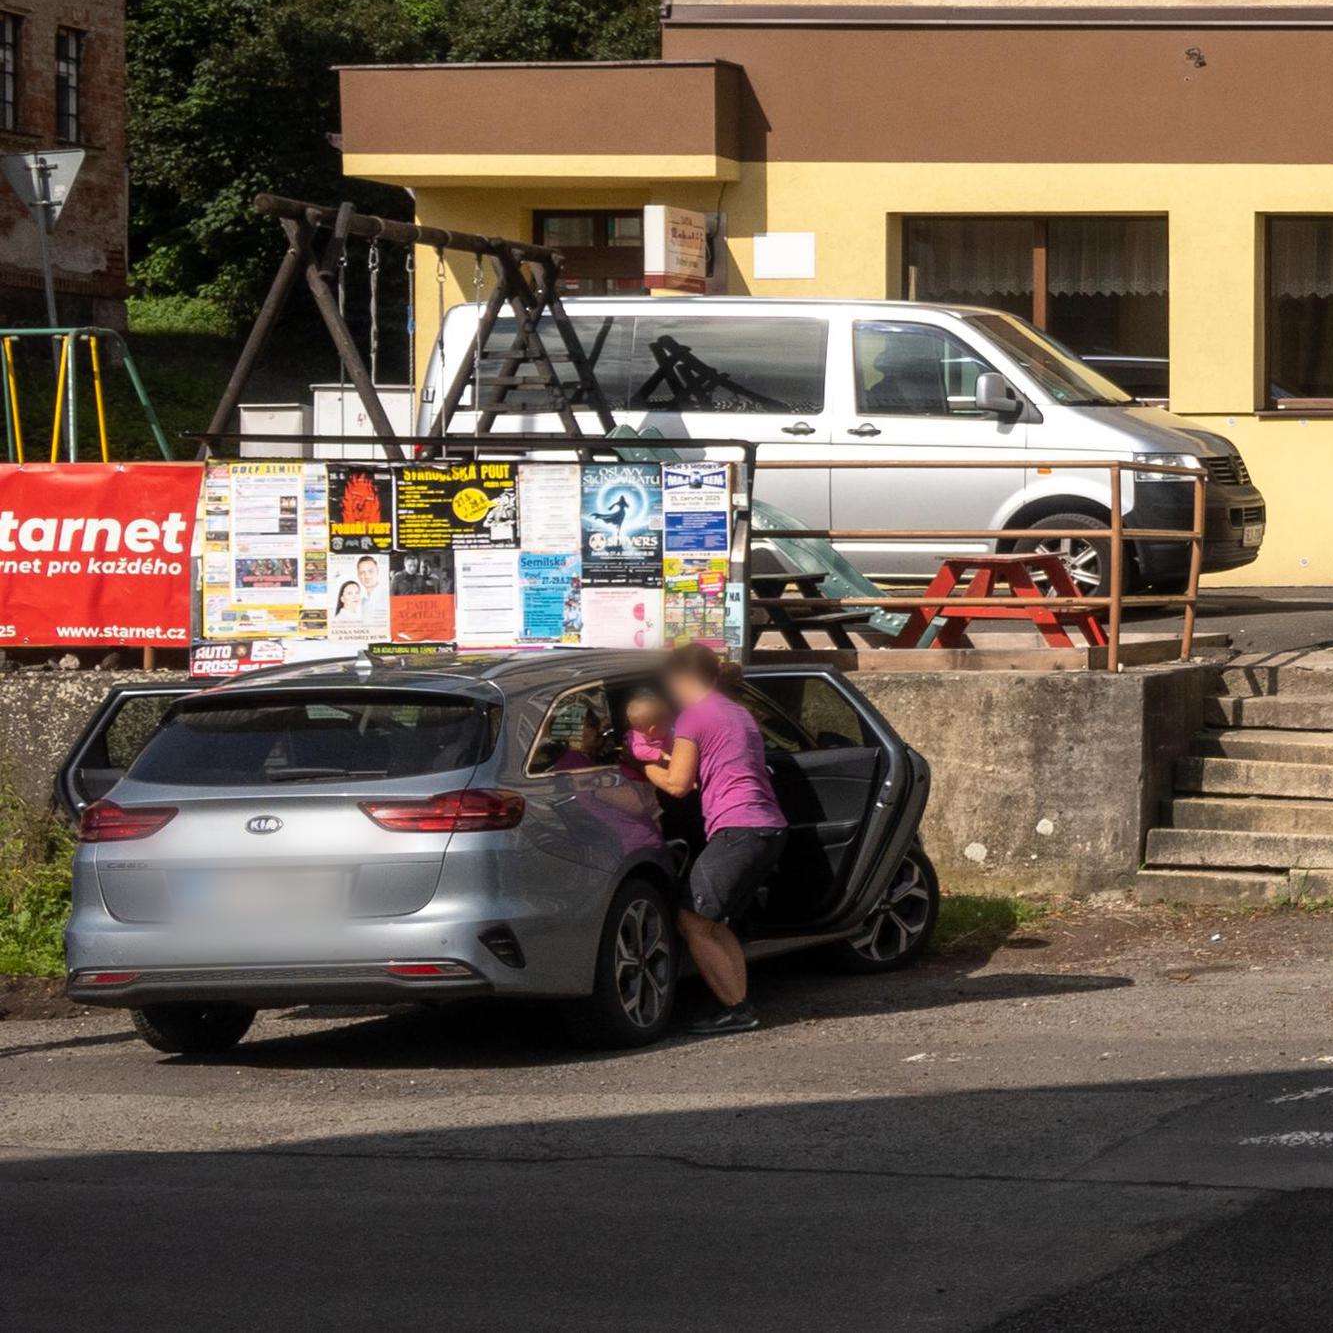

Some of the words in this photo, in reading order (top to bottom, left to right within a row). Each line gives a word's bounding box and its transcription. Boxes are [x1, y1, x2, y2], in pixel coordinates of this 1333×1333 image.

[231, 466, 260, 474] GOLF
[47, 560, 81, 577] pro
[87, 557, 182, 575] každého
[56, 626, 187, 639] www.starnet.cz
[195, 646, 232, 659] AUTO
[193, 659, 239, 673] CROSS
[250, 818, 278, 831] KIA
